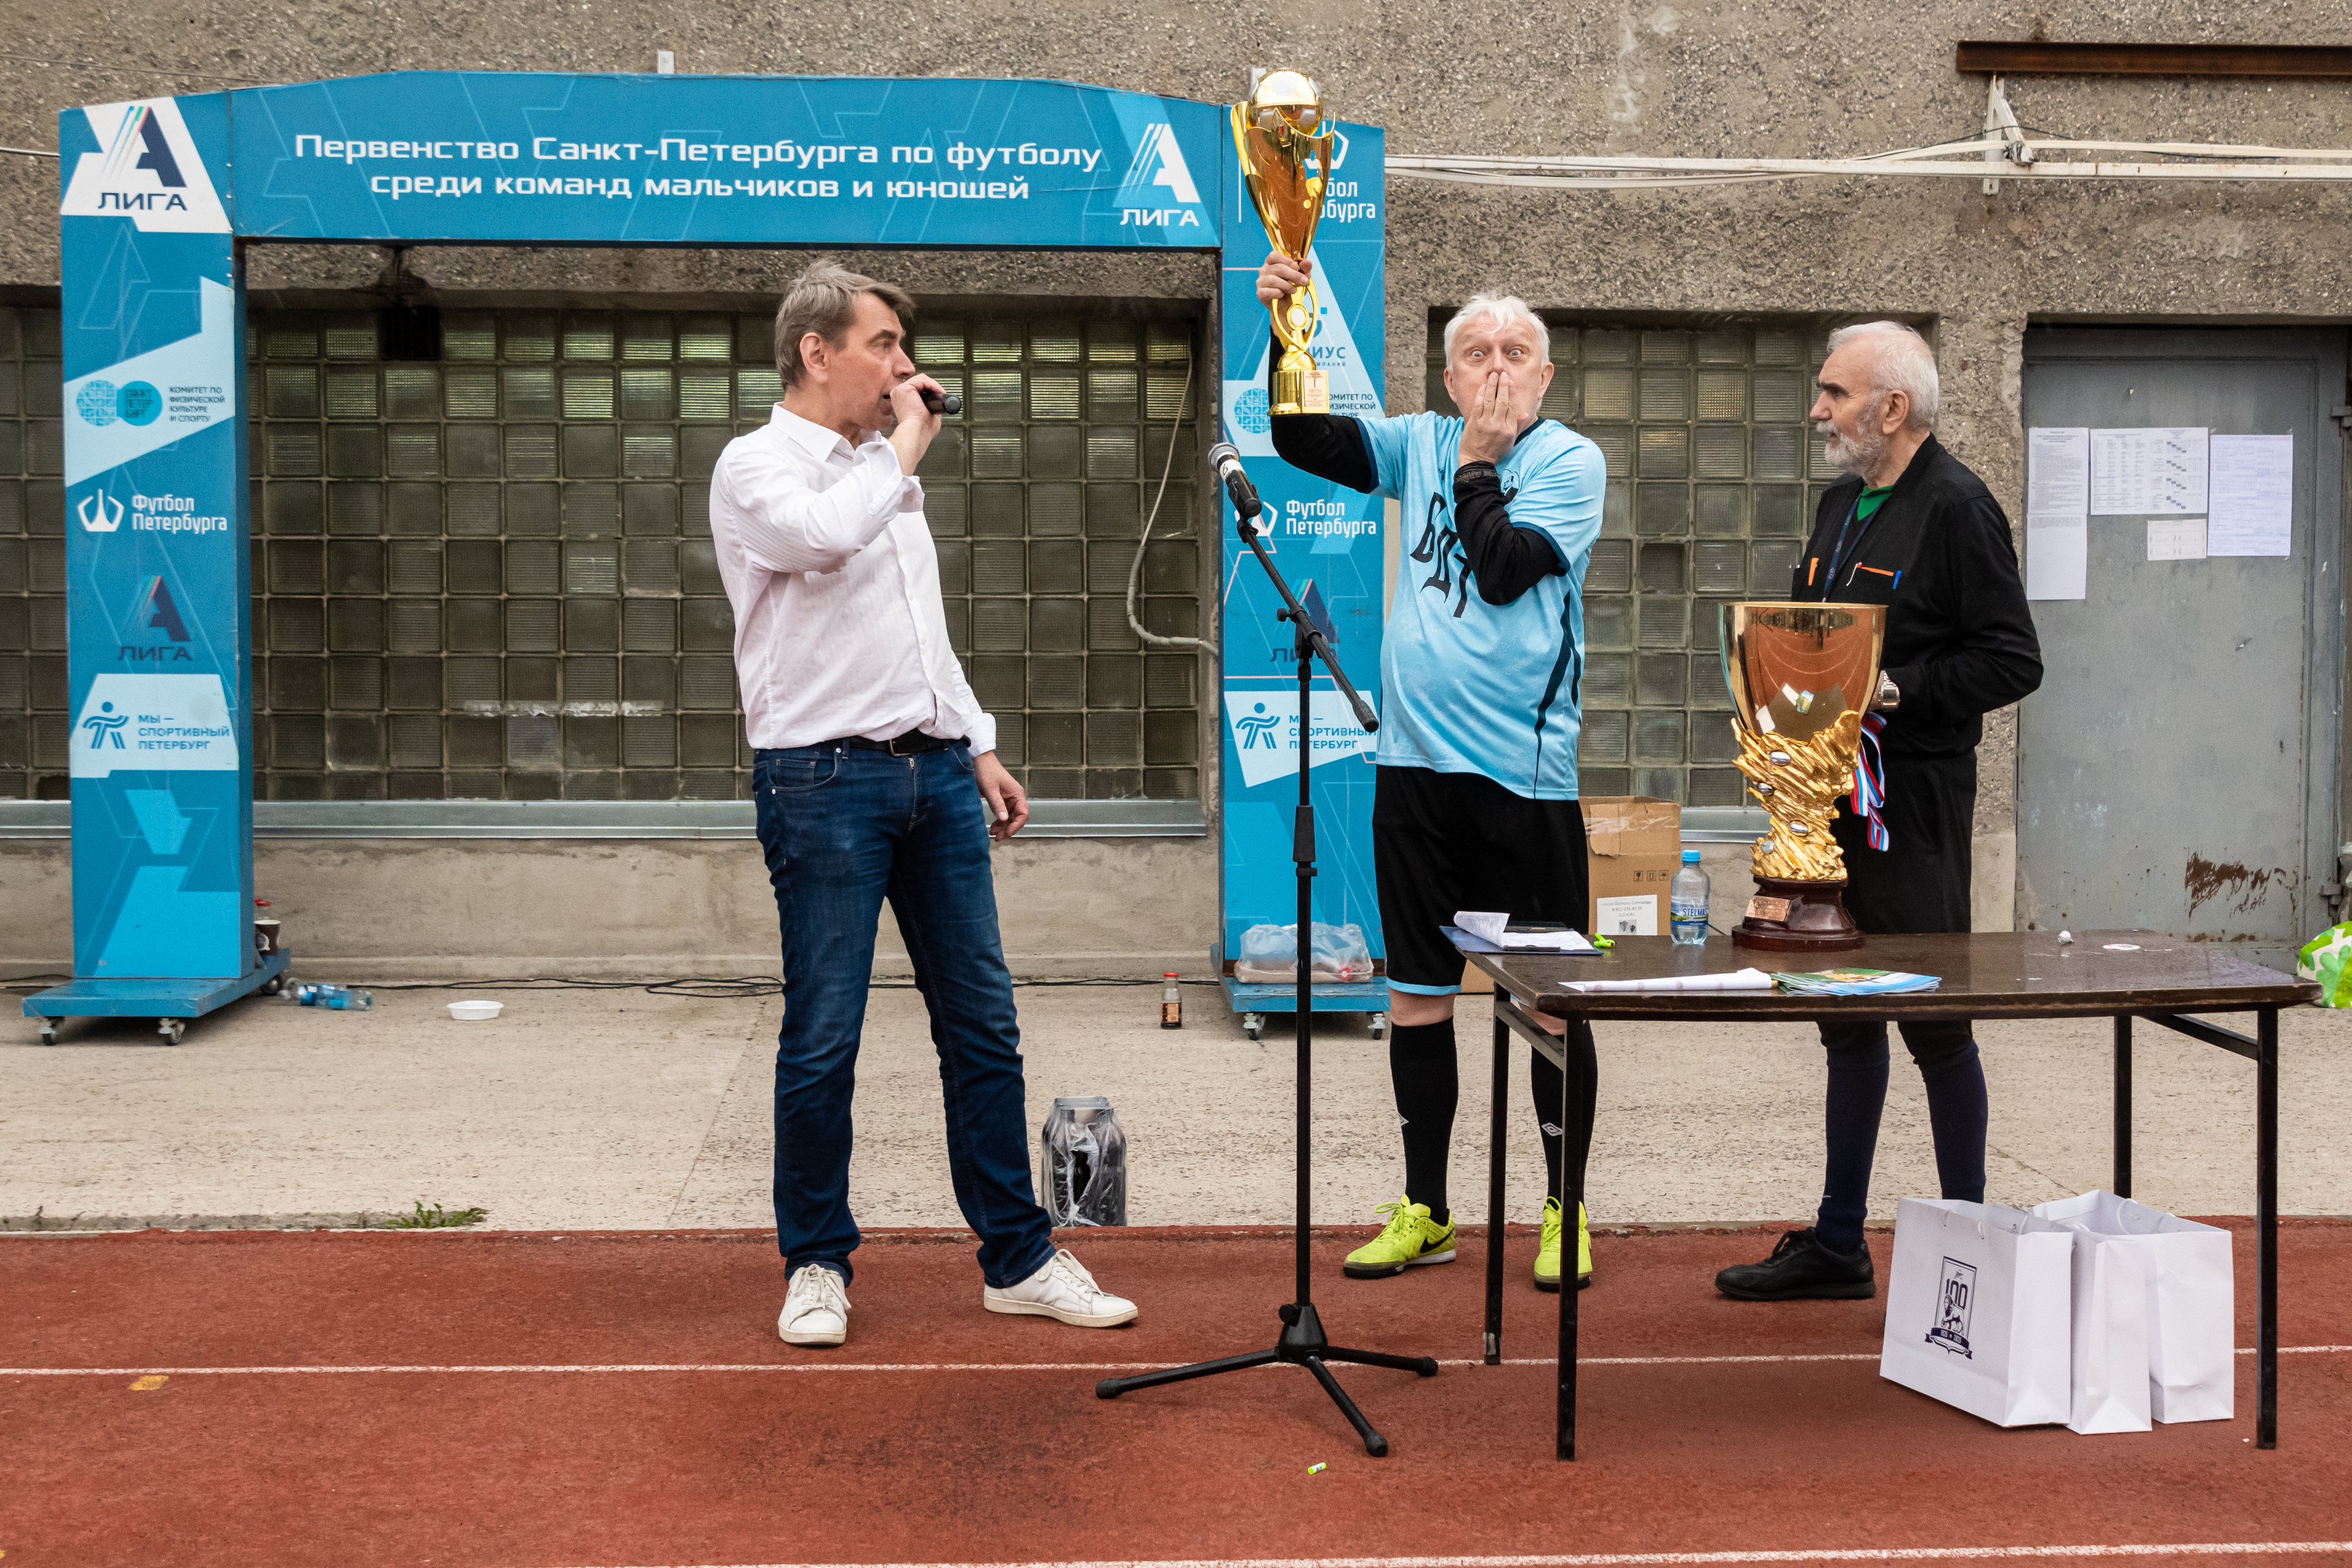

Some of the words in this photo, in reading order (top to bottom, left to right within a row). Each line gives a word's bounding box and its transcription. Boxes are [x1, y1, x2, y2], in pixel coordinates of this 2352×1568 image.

[296, 134, 519, 164] Первенство
[533, 137, 878, 169] Санкт-Петербурга
[892, 146, 934, 164] по
[947, 141, 1102, 172] футболу
[371, 176, 482, 200] среди
[495, 177, 632, 199] команд
[645, 178, 840, 197] мальчиков
[852, 180, 873, 198] и
[886, 175, 1030, 199] юношей
[1326, 178, 1358, 197] бол
[97, 192, 187, 211] ЛИГА
[1320, 199, 1376, 223] бурга
[1120, 209, 1200, 227] ЛИГА
[169, 395, 225, 404] ФИЗИЧЕСКОЙ
[132, 494, 195, 514] Футбол
[1286, 499, 1346, 520] Футбол
[132, 513, 228, 535] Петербурга
[1286, 518, 1376, 538] Петербурга
[117, 646, 193, 662] ЛИГА
[138, 715, 160, 723] МЫ
[138, 726, 230, 737] СПОРТИВНЫЙ
[1289, 728, 1376, 736] СОРТИВНЫ
[138, 741, 211, 750] ПЕТЕРБУРГ
